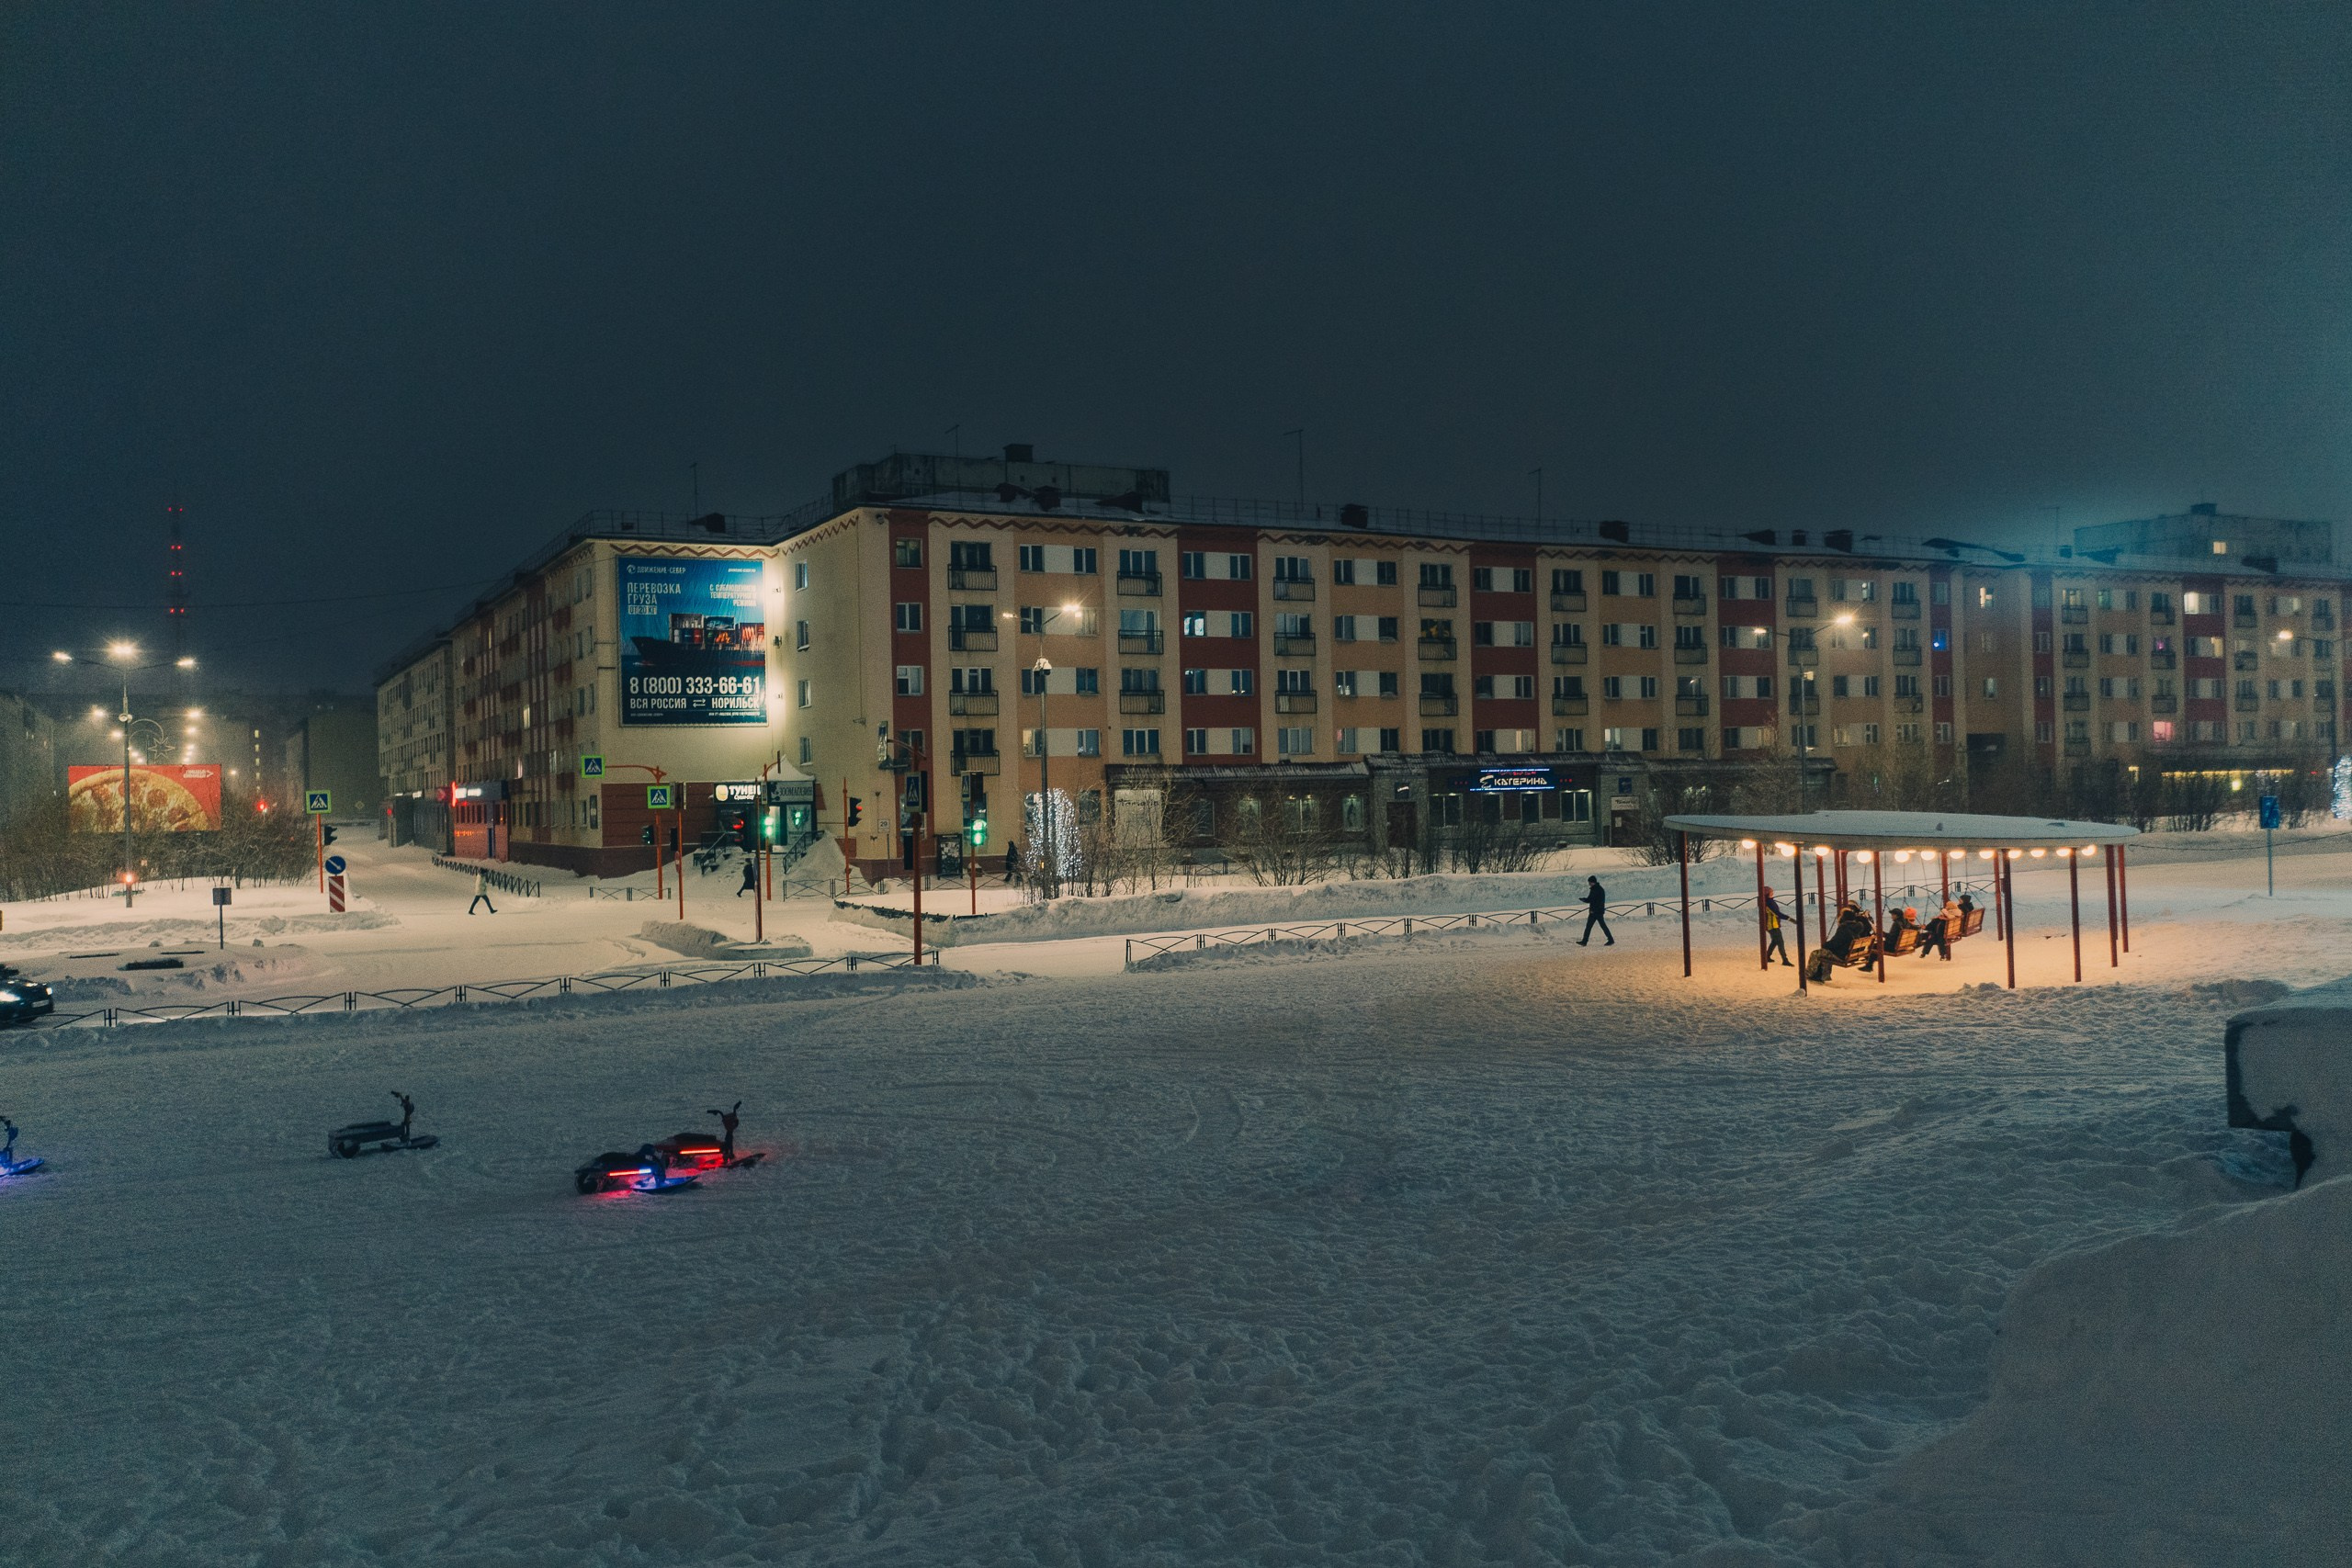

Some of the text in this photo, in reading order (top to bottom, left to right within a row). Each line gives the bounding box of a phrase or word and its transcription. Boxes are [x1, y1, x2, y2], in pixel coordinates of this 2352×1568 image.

[627, 581, 682, 594] ПЕРЕВОЗКА
[628, 593, 658, 604] ГРУЗА
[629, 676, 760, 694] 8 (800) 333-66-61
[629, 697, 760, 709] ВСЯ РОССИЯ НОРИЛЬСК
